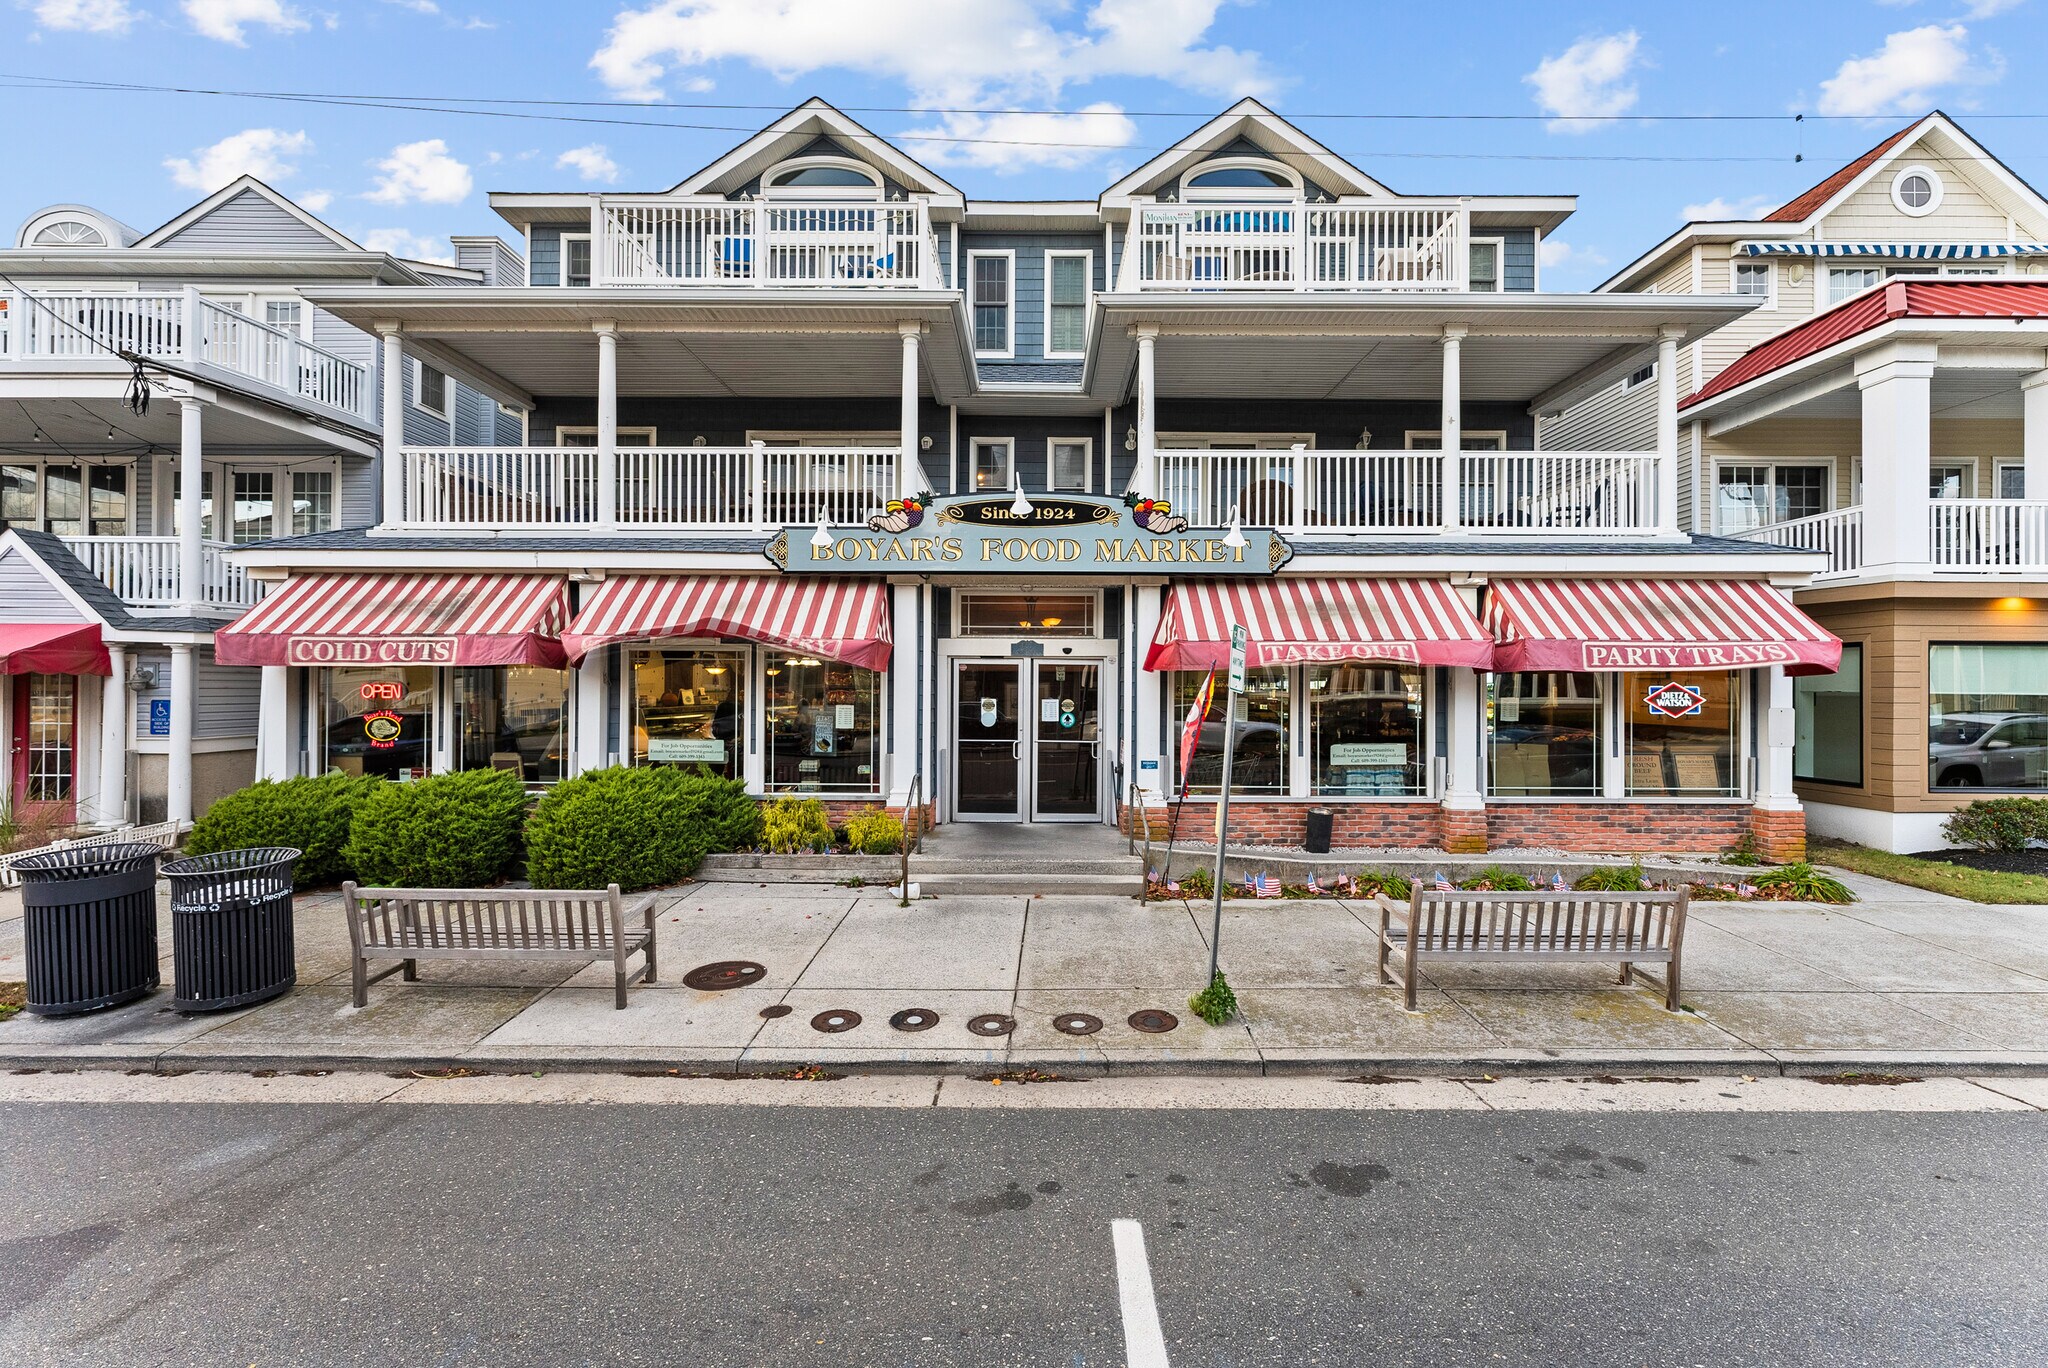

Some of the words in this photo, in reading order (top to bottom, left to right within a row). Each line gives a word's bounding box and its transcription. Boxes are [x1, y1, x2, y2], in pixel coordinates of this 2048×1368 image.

[1035, 507, 1076, 520] 1924
[810, 536, 963, 562] BOYAR'S
[980, 537, 1082, 562] FOOD
[1094, 538, 1252, 563] MARKET
[295, 641, 372, 661] COLD
[379, 641, 450, 661] CUTS
[1265, 645, 1346, 662] TAKE
[1352, 645, 1410, 660] OUT
[1589, 647, 1681, 666] PARTY
[1686, 644, 1787, 666] TRAYS
[361, 683, 402, 699] OPEN
[1656, 698, 1693, 707] WATSON
[364, 710, 384, 722] Boar's
[385, 709, 403, 723] Head
[370, 740, 394, 749] Brand
[262, 888, 289, 902] Recycle
[176, 904, 206, 913] Recycle
